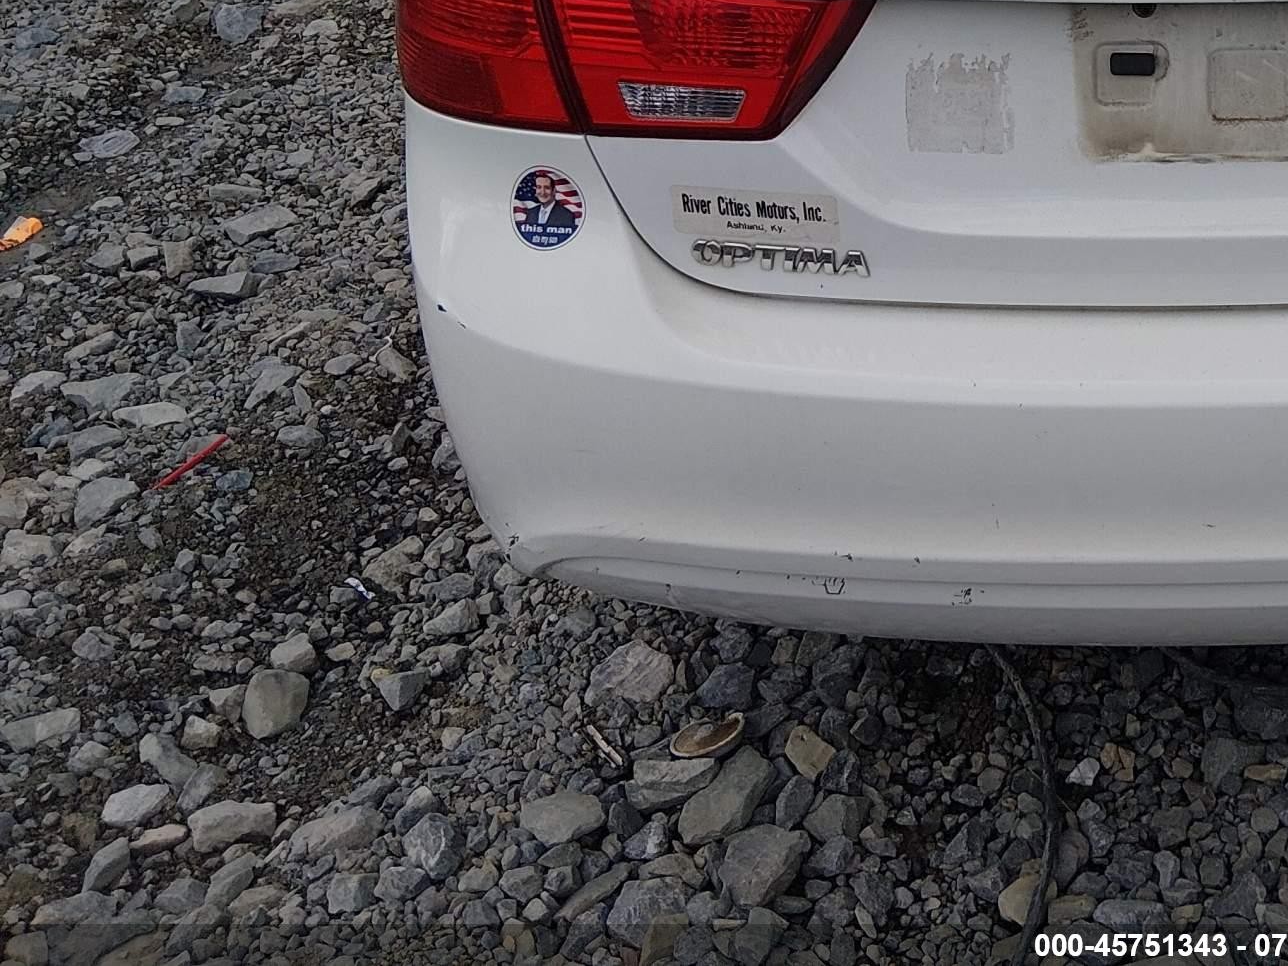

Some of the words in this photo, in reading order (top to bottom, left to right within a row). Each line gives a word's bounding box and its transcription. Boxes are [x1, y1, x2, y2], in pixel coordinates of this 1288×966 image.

[682, 193, 711, 214] River
[717, 196, 751, 217] Cities
[803, 201, 826, 222] Inc.
[520, 224, 543, 233] this
[546, 226, 572, 234] man
[771, 224, 786, 234] Ky.
[691, 238, 871, 277] OPTIMA
